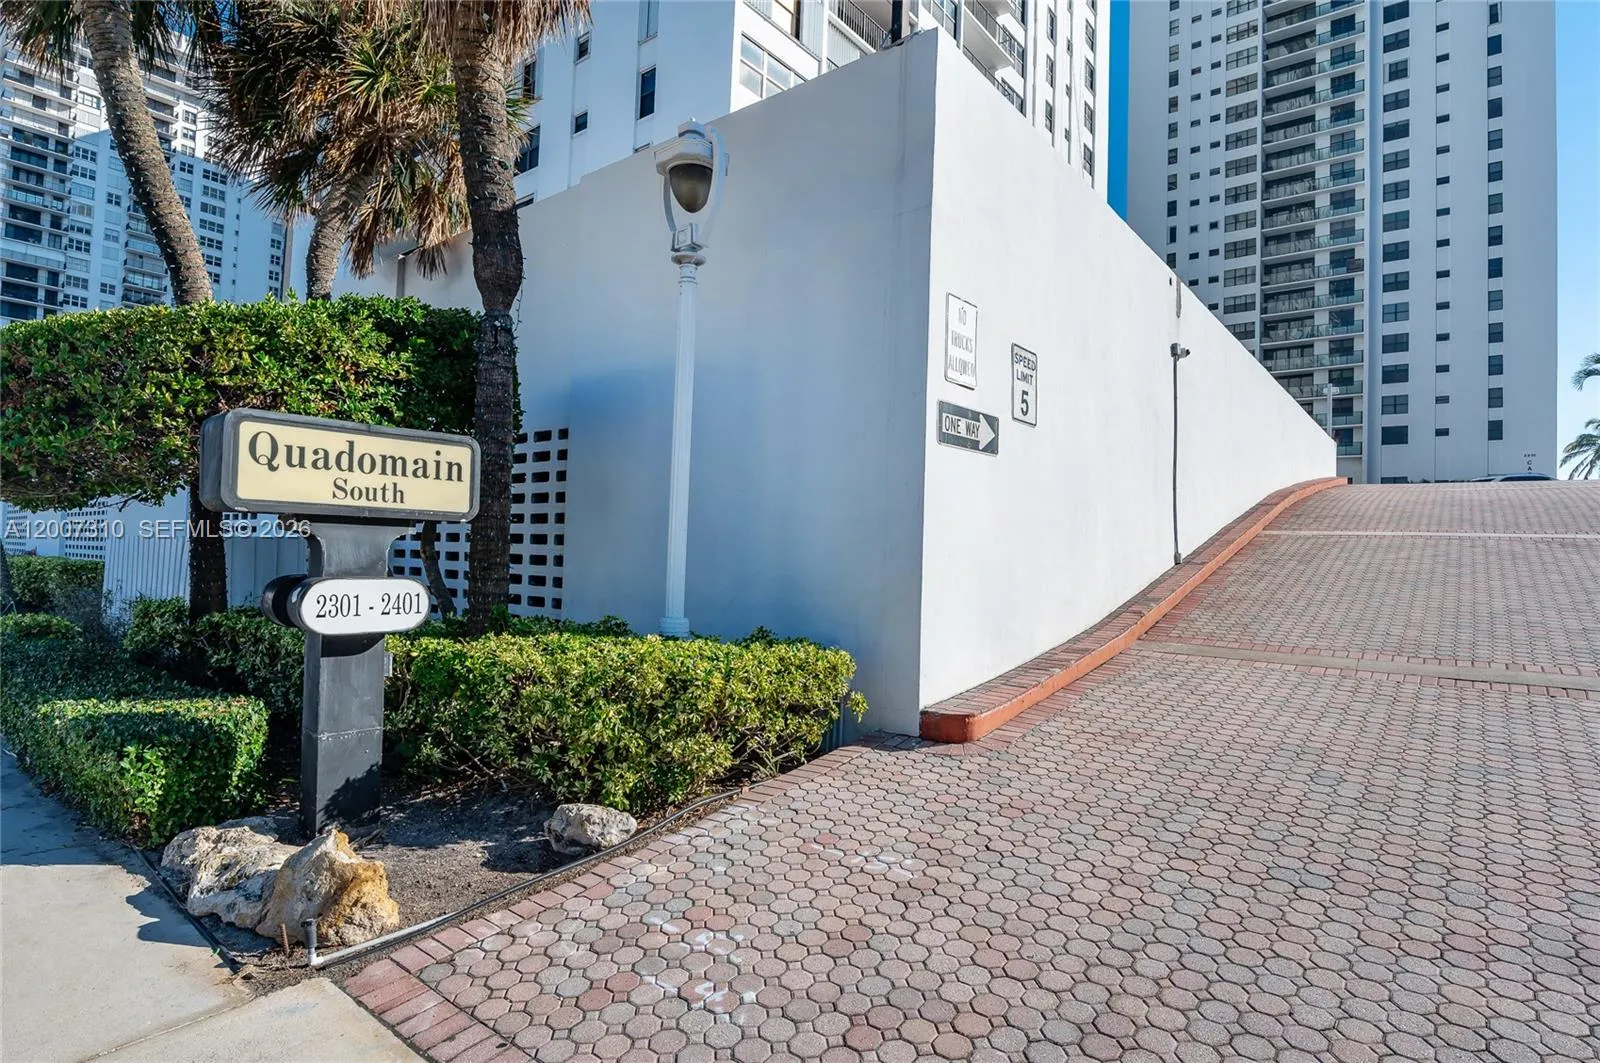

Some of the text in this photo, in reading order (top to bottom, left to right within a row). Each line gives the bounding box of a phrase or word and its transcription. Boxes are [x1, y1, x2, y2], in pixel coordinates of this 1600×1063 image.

[958, 306, 967, 326] NO
[951, 330, 973, 353] TRUCKS
[1014, 352, 1036, 372] SPEED
[1016, 369, 1034, 386] LIMIT
[1020, 390, 1029, 417] 5
[944, 415, 981, 439] ONE WAY
[248, 430, 464, 482] Quadomain
[332, 476, 405, 504] South
[315, 593, 361, 619] 2301
[381, 592, 422, 616] 2401
